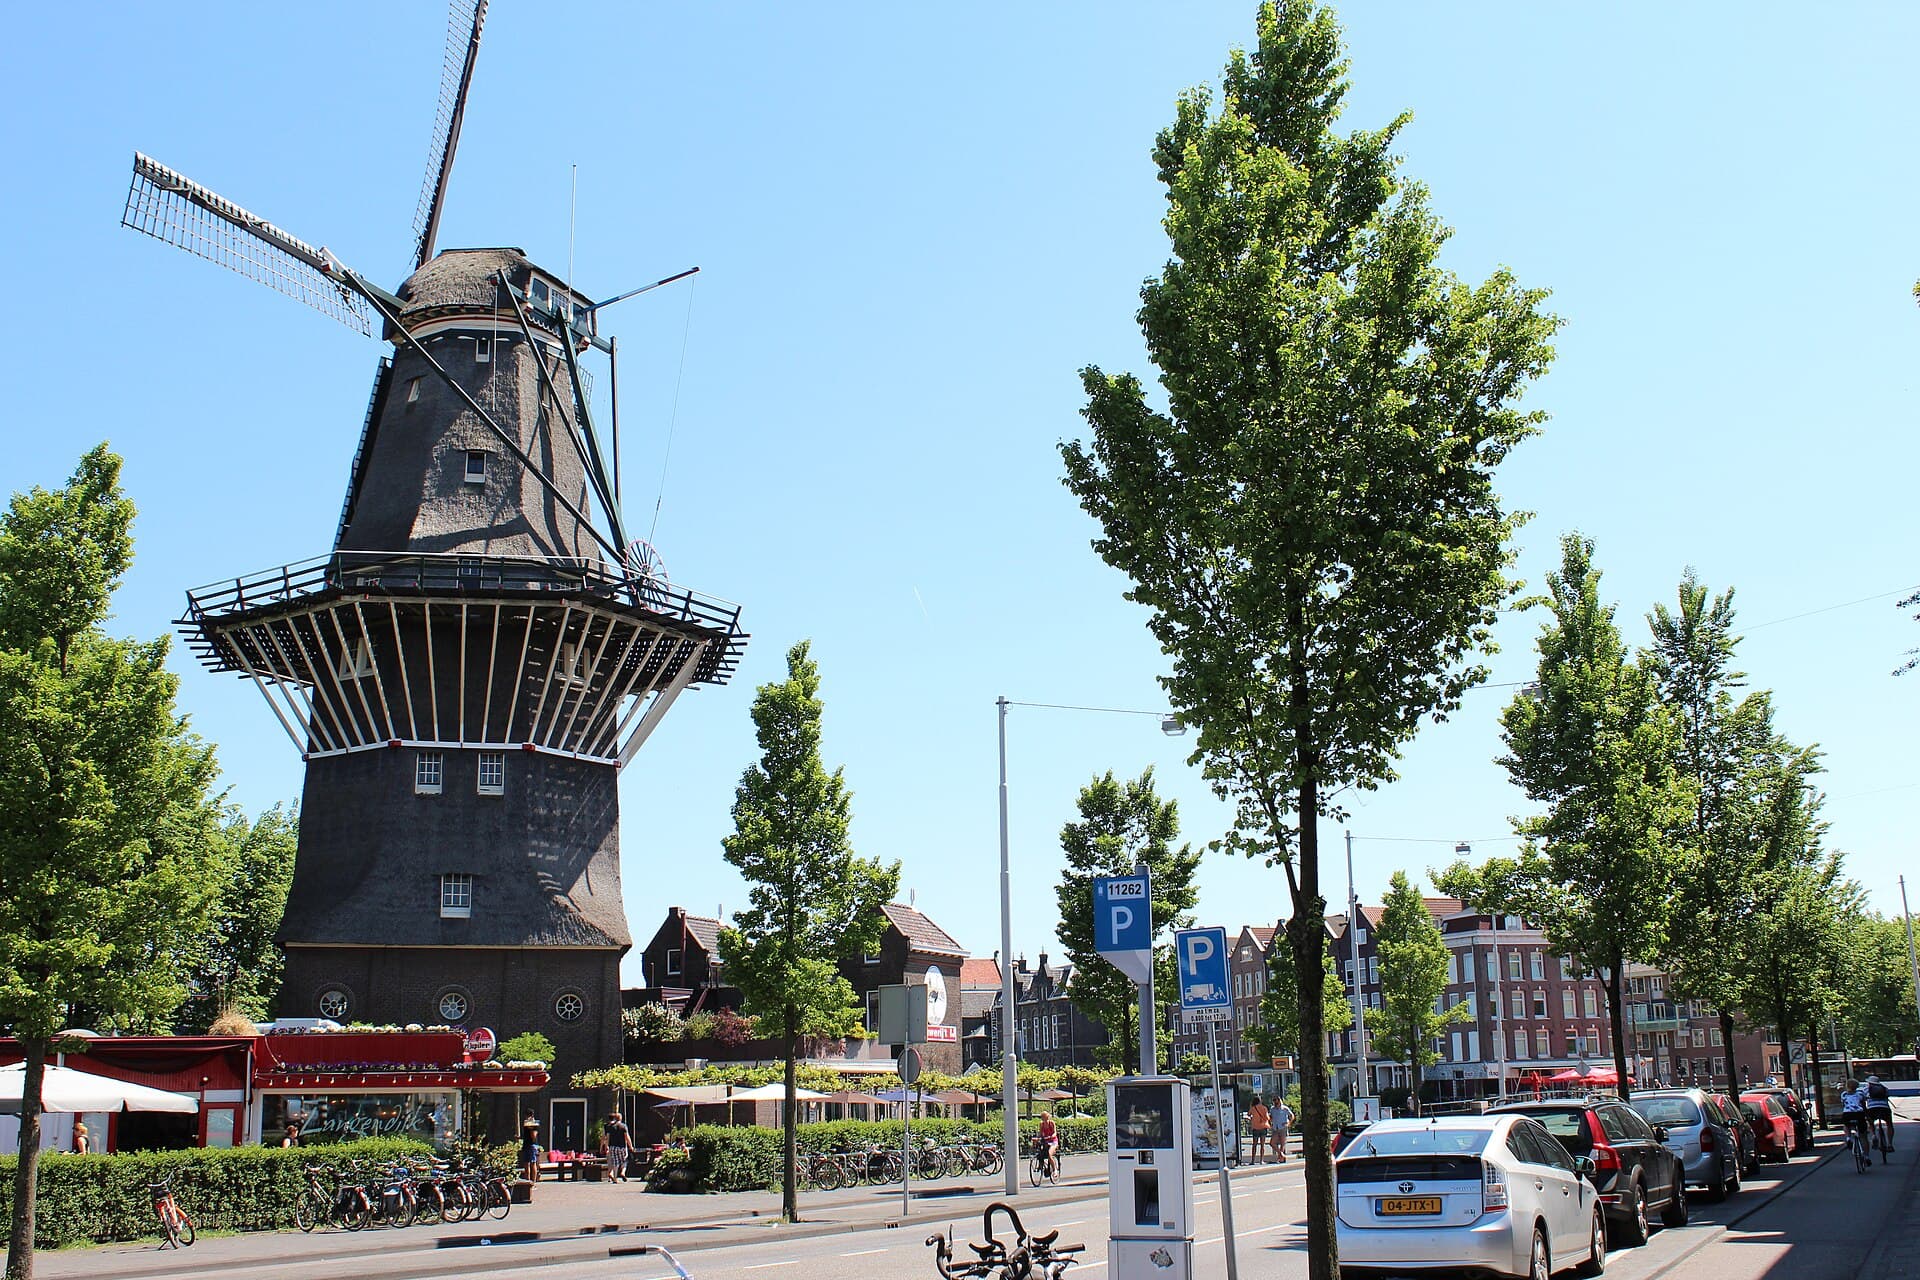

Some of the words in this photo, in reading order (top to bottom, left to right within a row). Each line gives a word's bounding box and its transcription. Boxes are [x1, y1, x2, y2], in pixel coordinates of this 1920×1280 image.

[1109, 884, 1142, 895] 11262
[1111, 906, 1133, 944] P
[1187, 936, 1214, 976] P
[1387, 1200, 1434, 1211] 04-JTX-1
